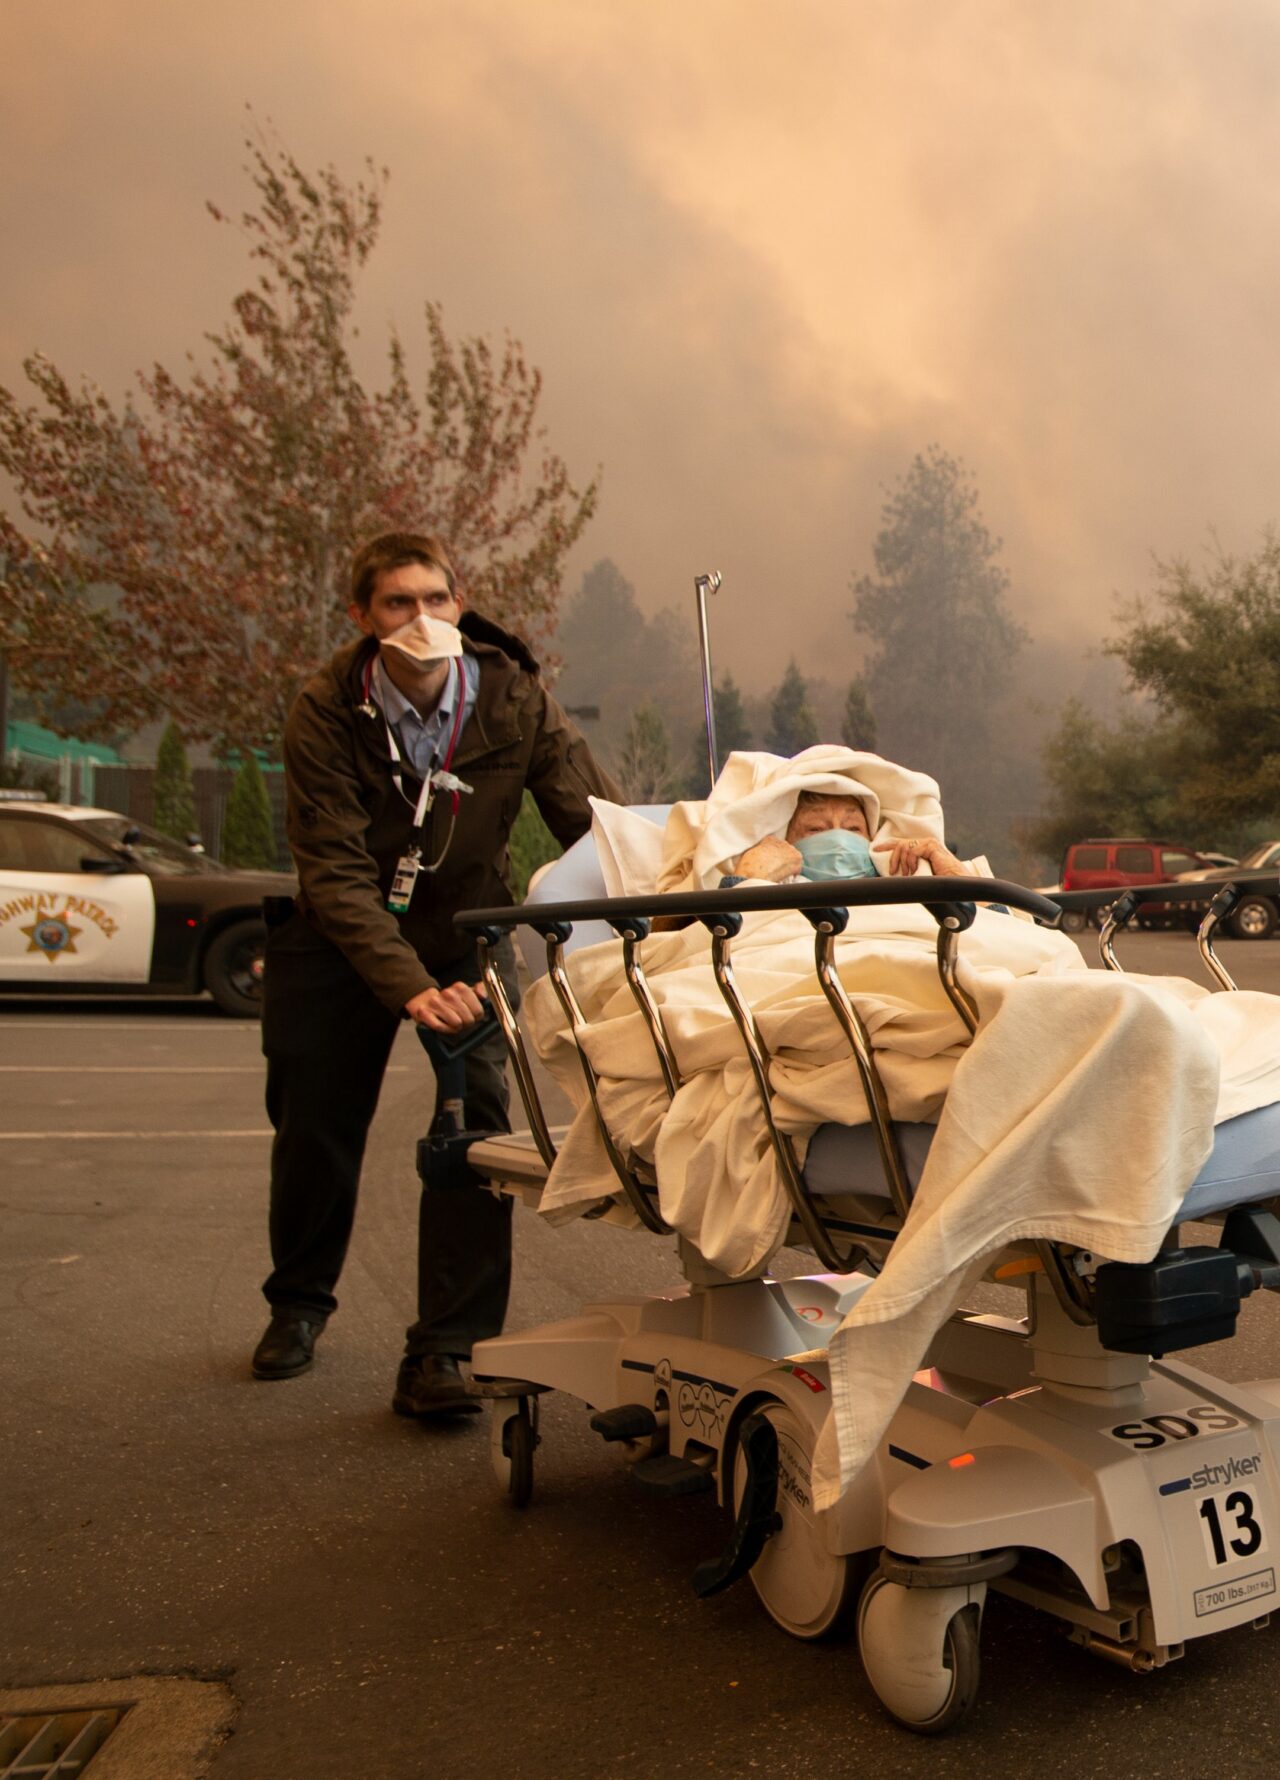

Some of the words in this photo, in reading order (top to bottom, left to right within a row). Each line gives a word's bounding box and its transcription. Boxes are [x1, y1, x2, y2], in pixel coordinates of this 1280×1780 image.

[0, 892, 58, 928] GHWAY
[64, 895, 118, 939] PATROL
[1112, 1407, 1239, 1449] SDS
[776, 1460, 810, 1508] tryker
[1192, 1456, 1261, 1490] stryker
[1200, 1491, 1261, 1565] 13
[1206, 1591, 1226, 1607] 700
[1228, 1586, 1247, 1600] lbs.
